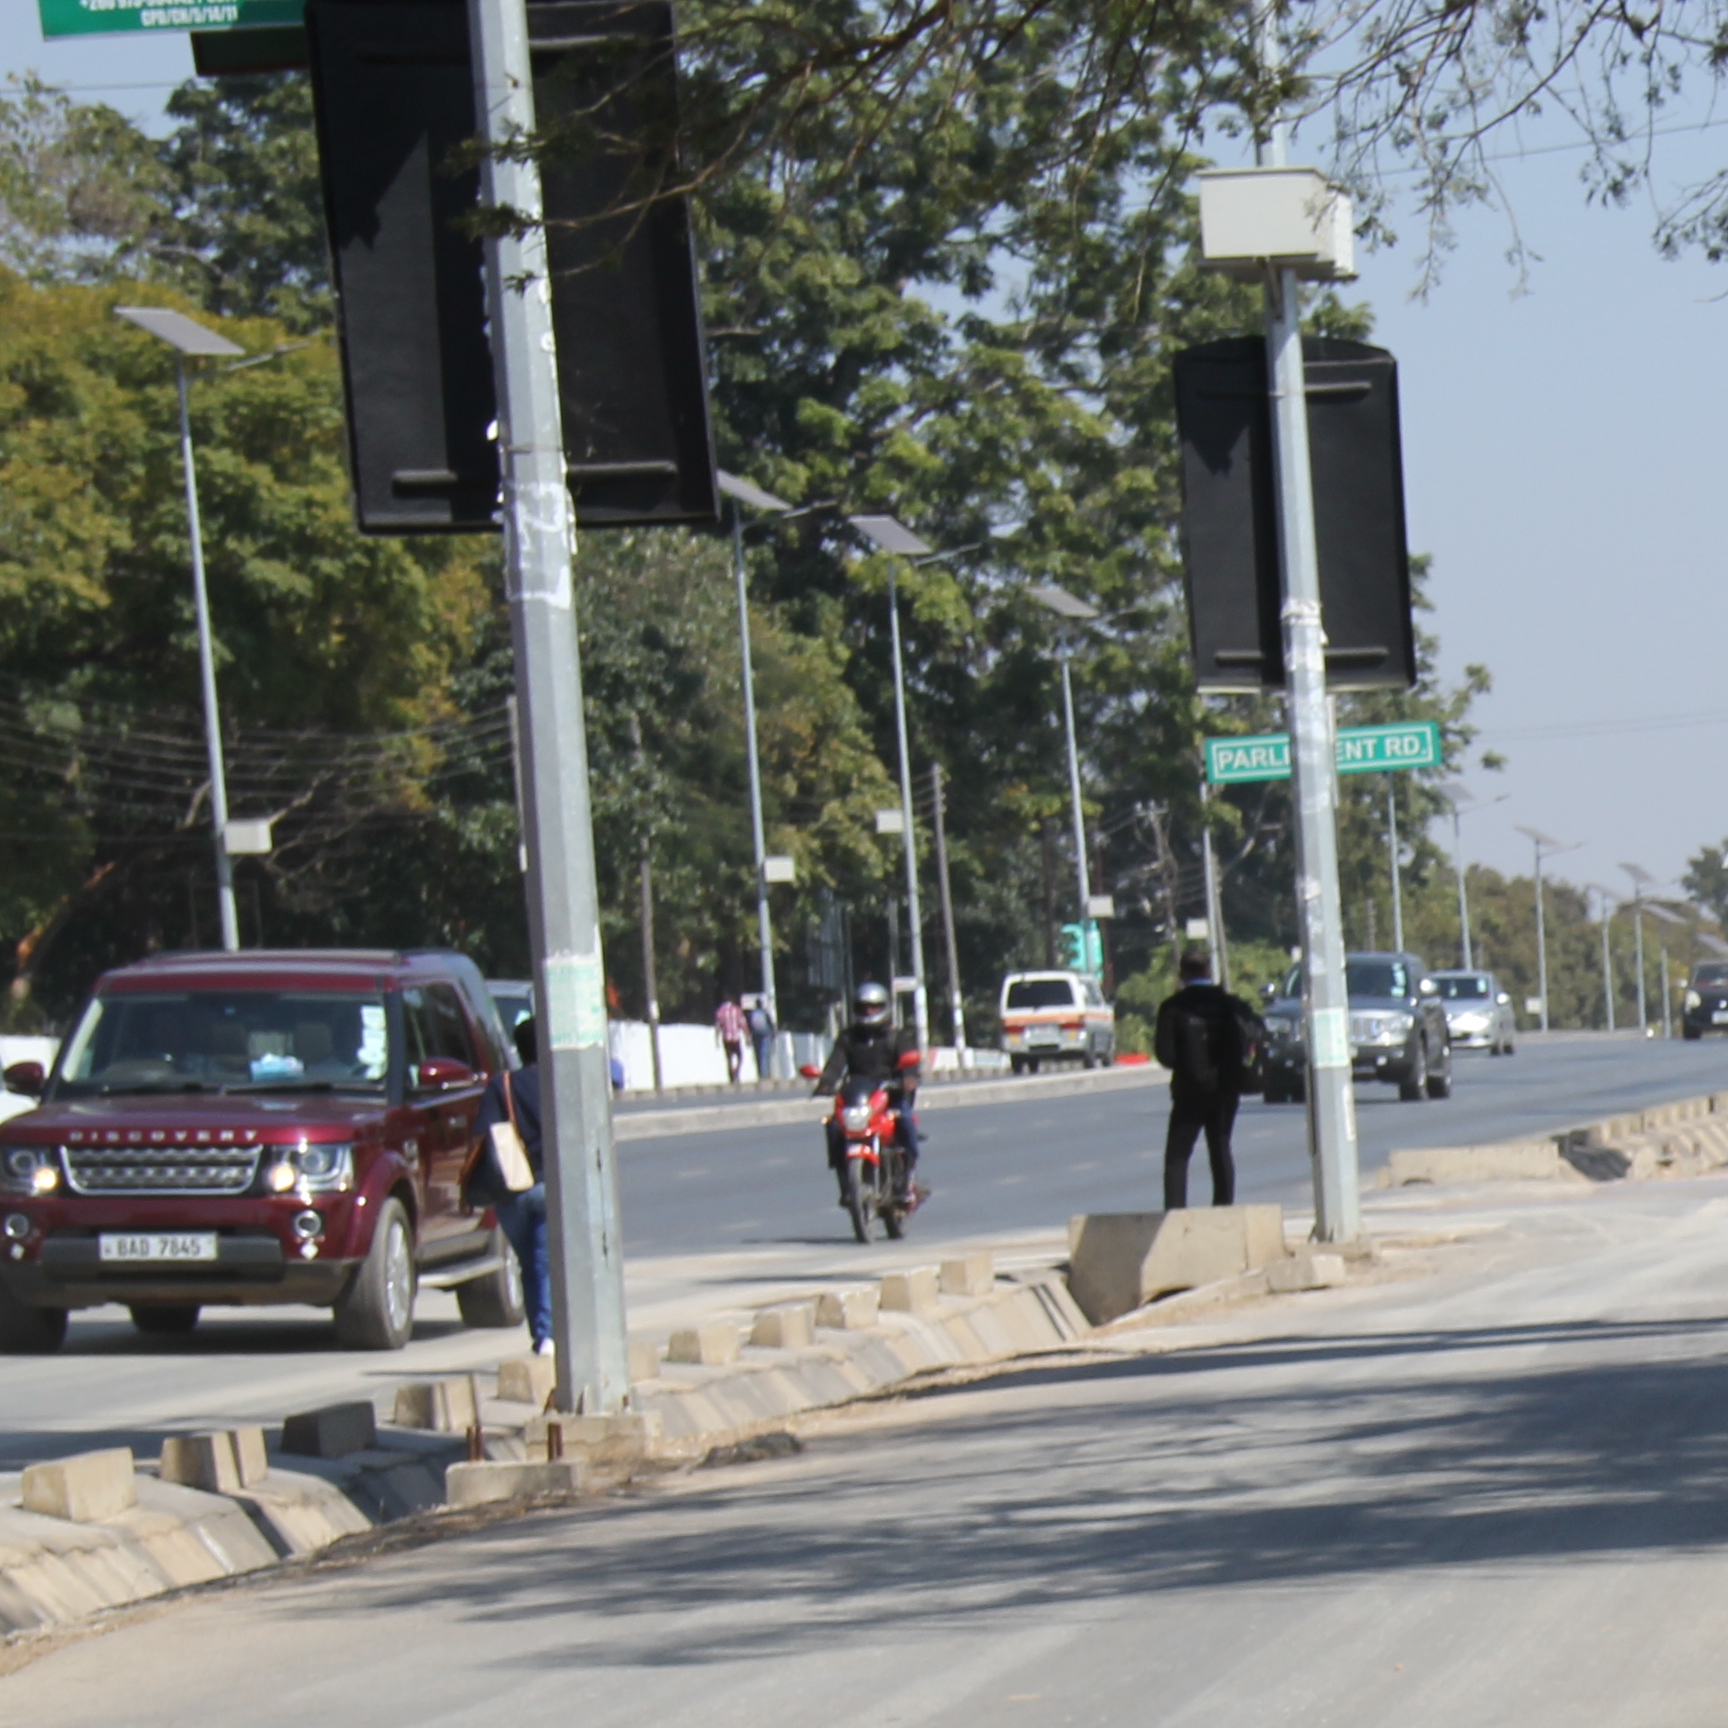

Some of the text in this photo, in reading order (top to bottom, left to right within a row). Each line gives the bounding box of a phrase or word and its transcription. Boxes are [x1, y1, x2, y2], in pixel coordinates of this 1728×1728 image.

[1217, 738, 1378, 770] PARLIENT
[69, 1130, 257, 1142] DISCOVERY
[117, 1237, 149, 1256] BAD
